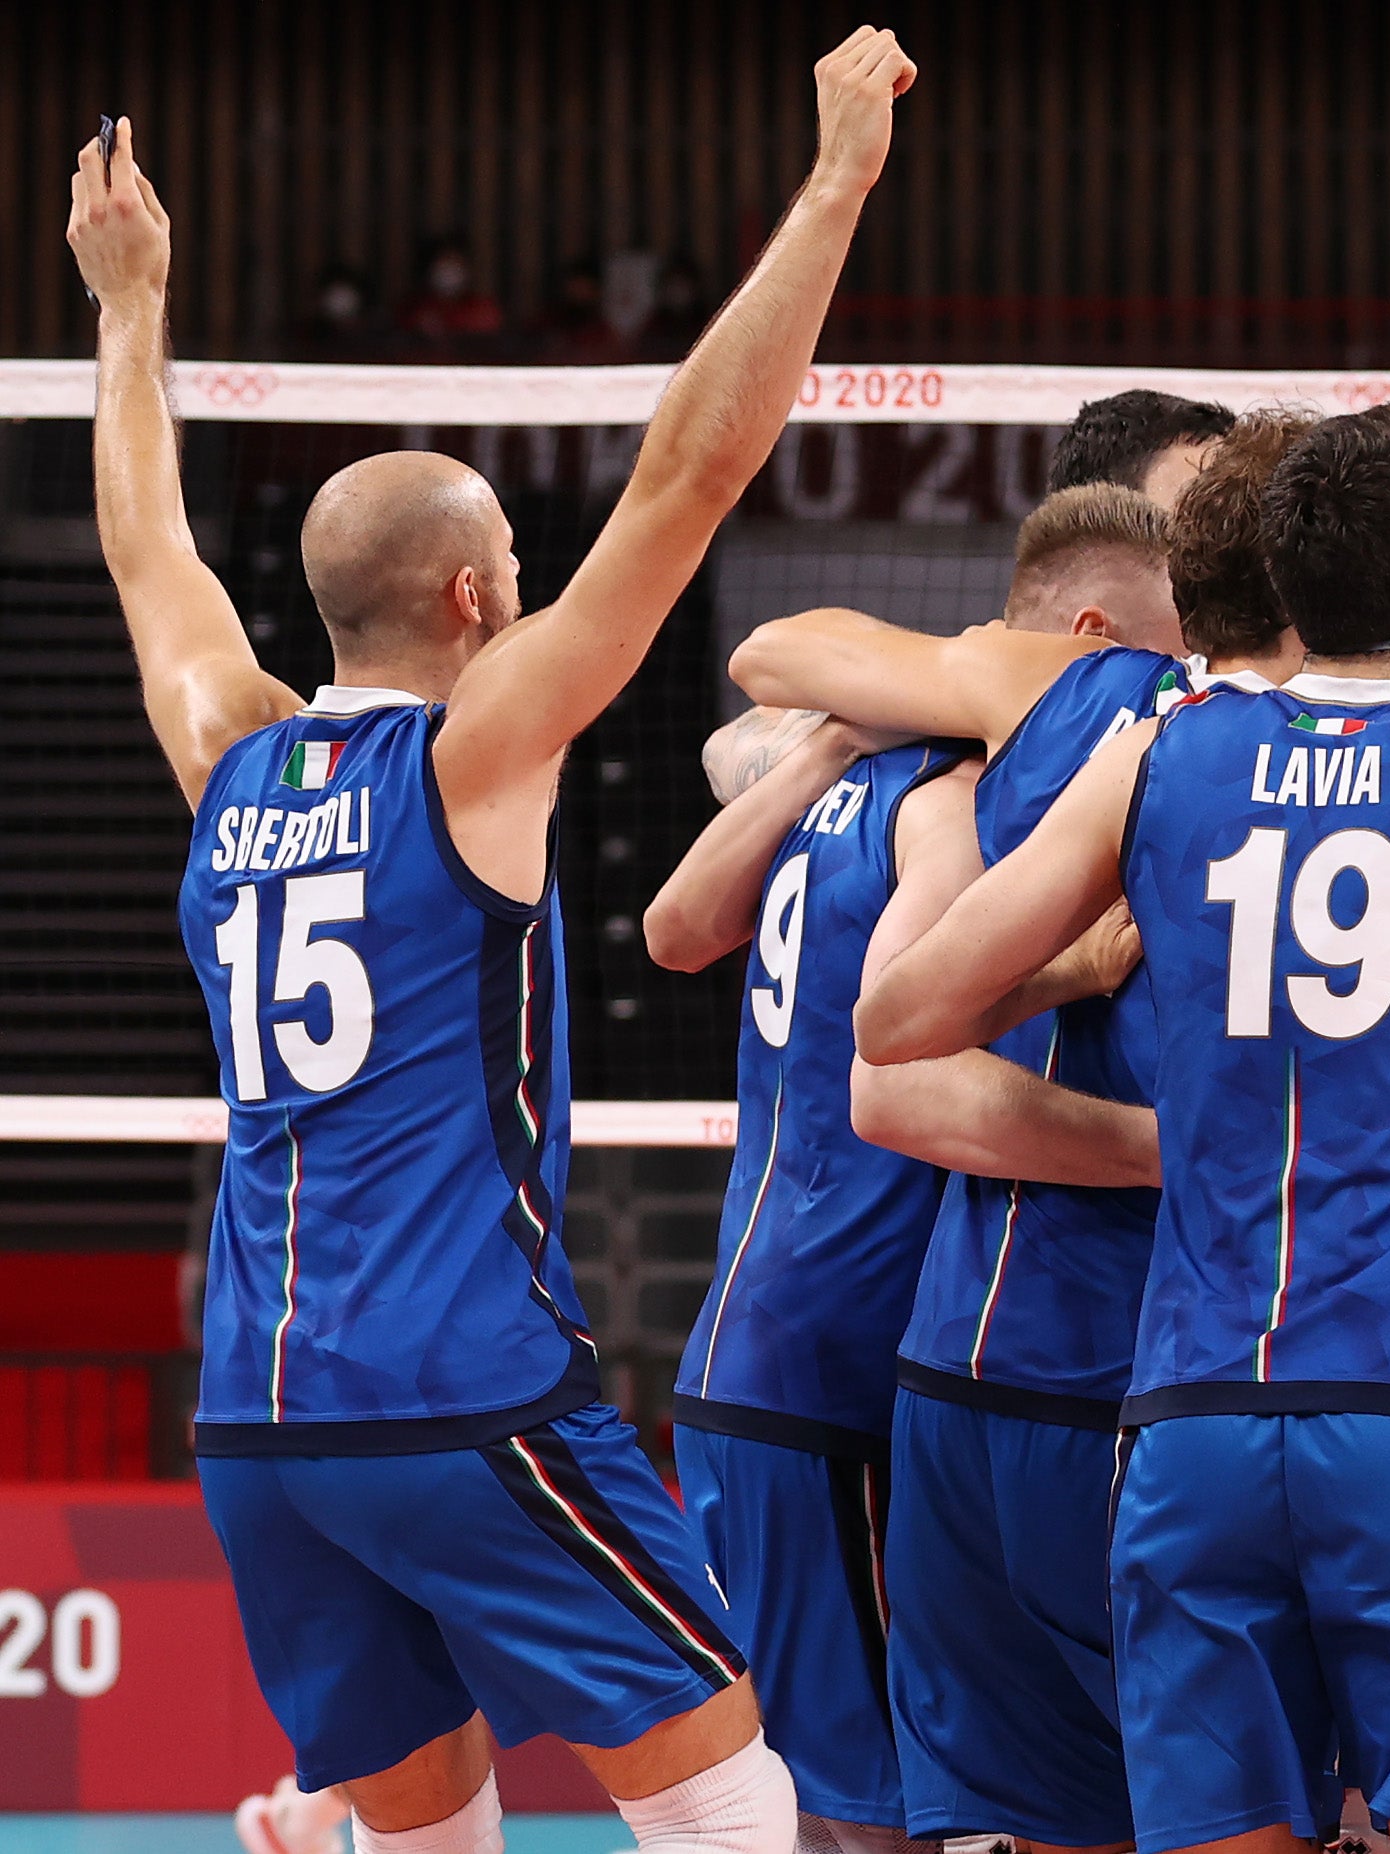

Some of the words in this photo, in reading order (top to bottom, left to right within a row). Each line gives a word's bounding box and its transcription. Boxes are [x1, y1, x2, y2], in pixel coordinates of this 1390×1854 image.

[836, 370, 943, 407] 2020
[1251, 744, 1381, 806] LAVIA
[212, 786, 371, 872] SBERTOLI
[215, 869, 375, 1101] 15
[751, 851, 810, 1048] 9
[0, 1588, 121, 1698] 20
